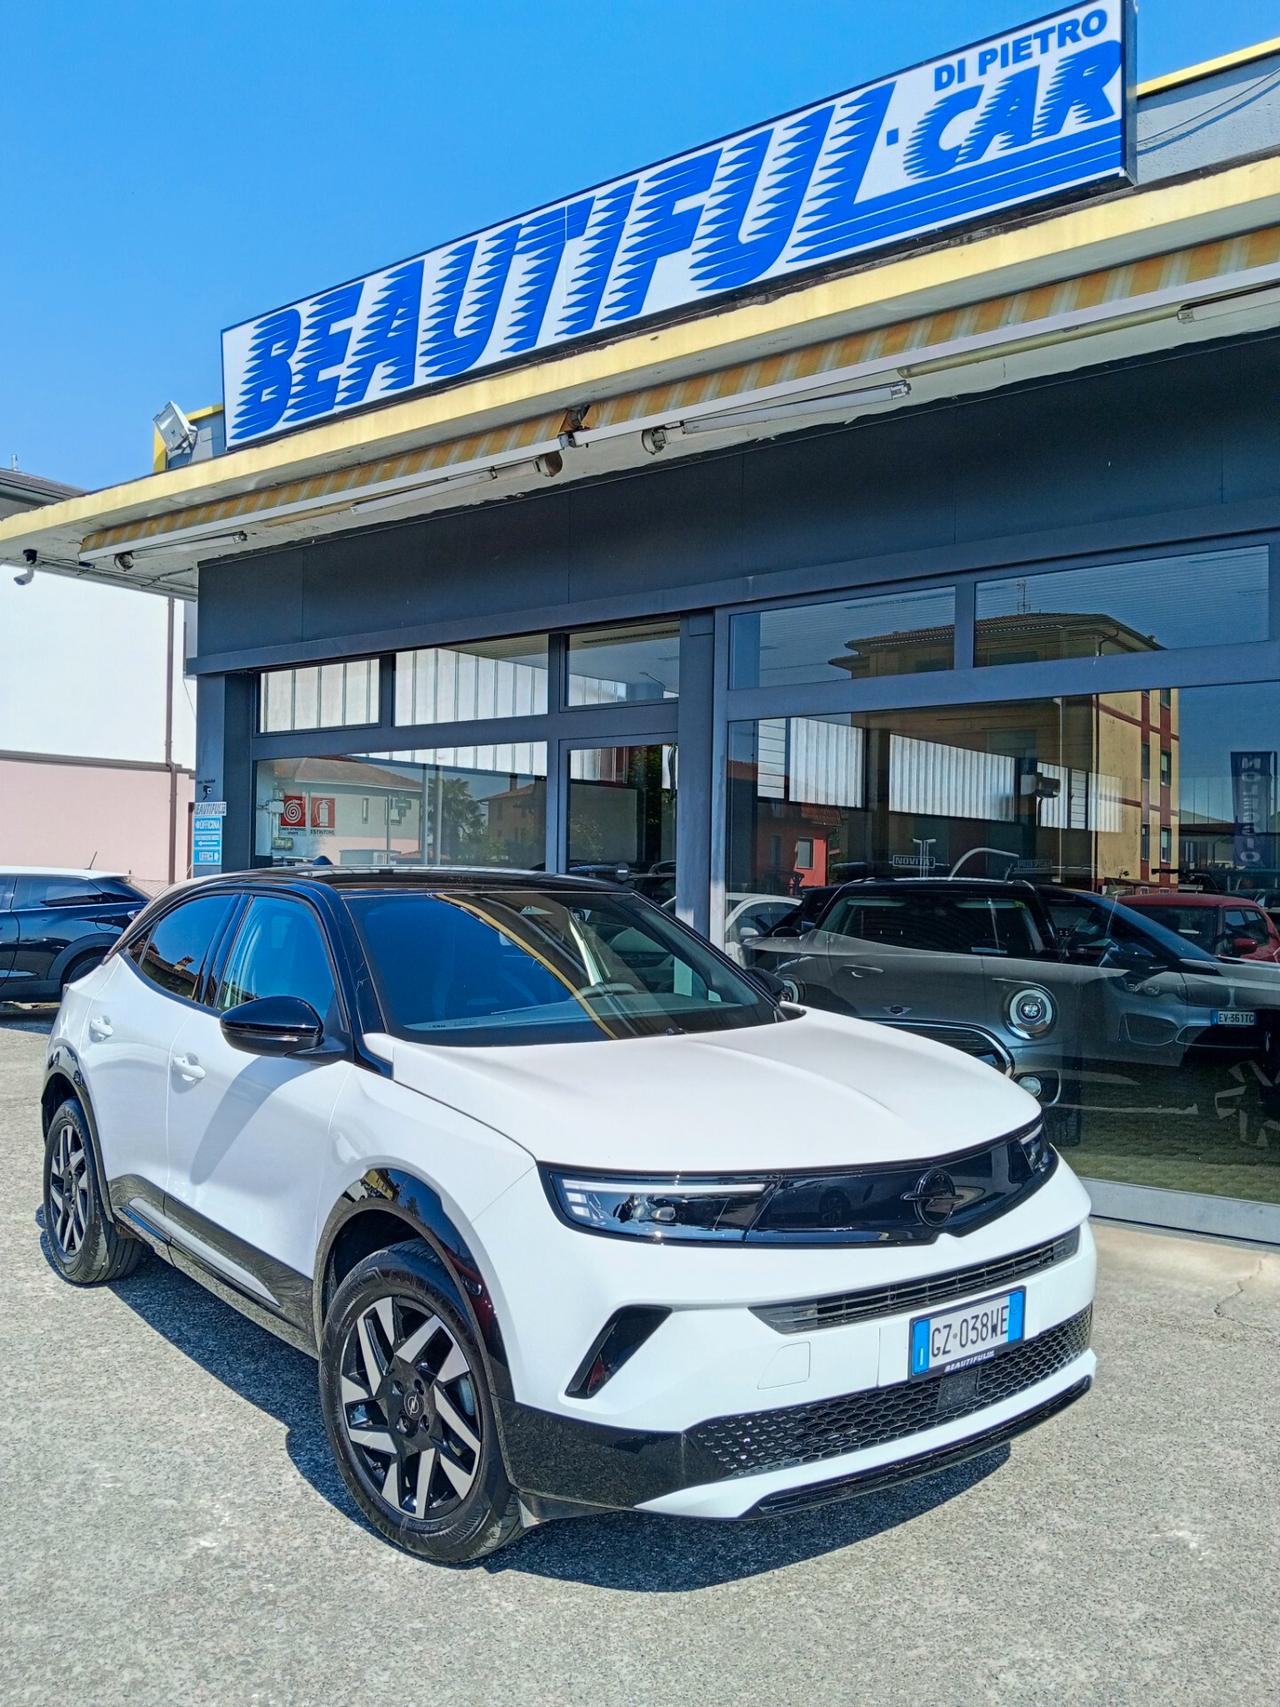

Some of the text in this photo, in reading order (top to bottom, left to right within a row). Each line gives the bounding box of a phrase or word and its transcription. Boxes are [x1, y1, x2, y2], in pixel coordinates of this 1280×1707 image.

[934, 8, 1108, 92] DI PIETRO
[231, 40, 1121, 440] BEAUTIFUL CAR
